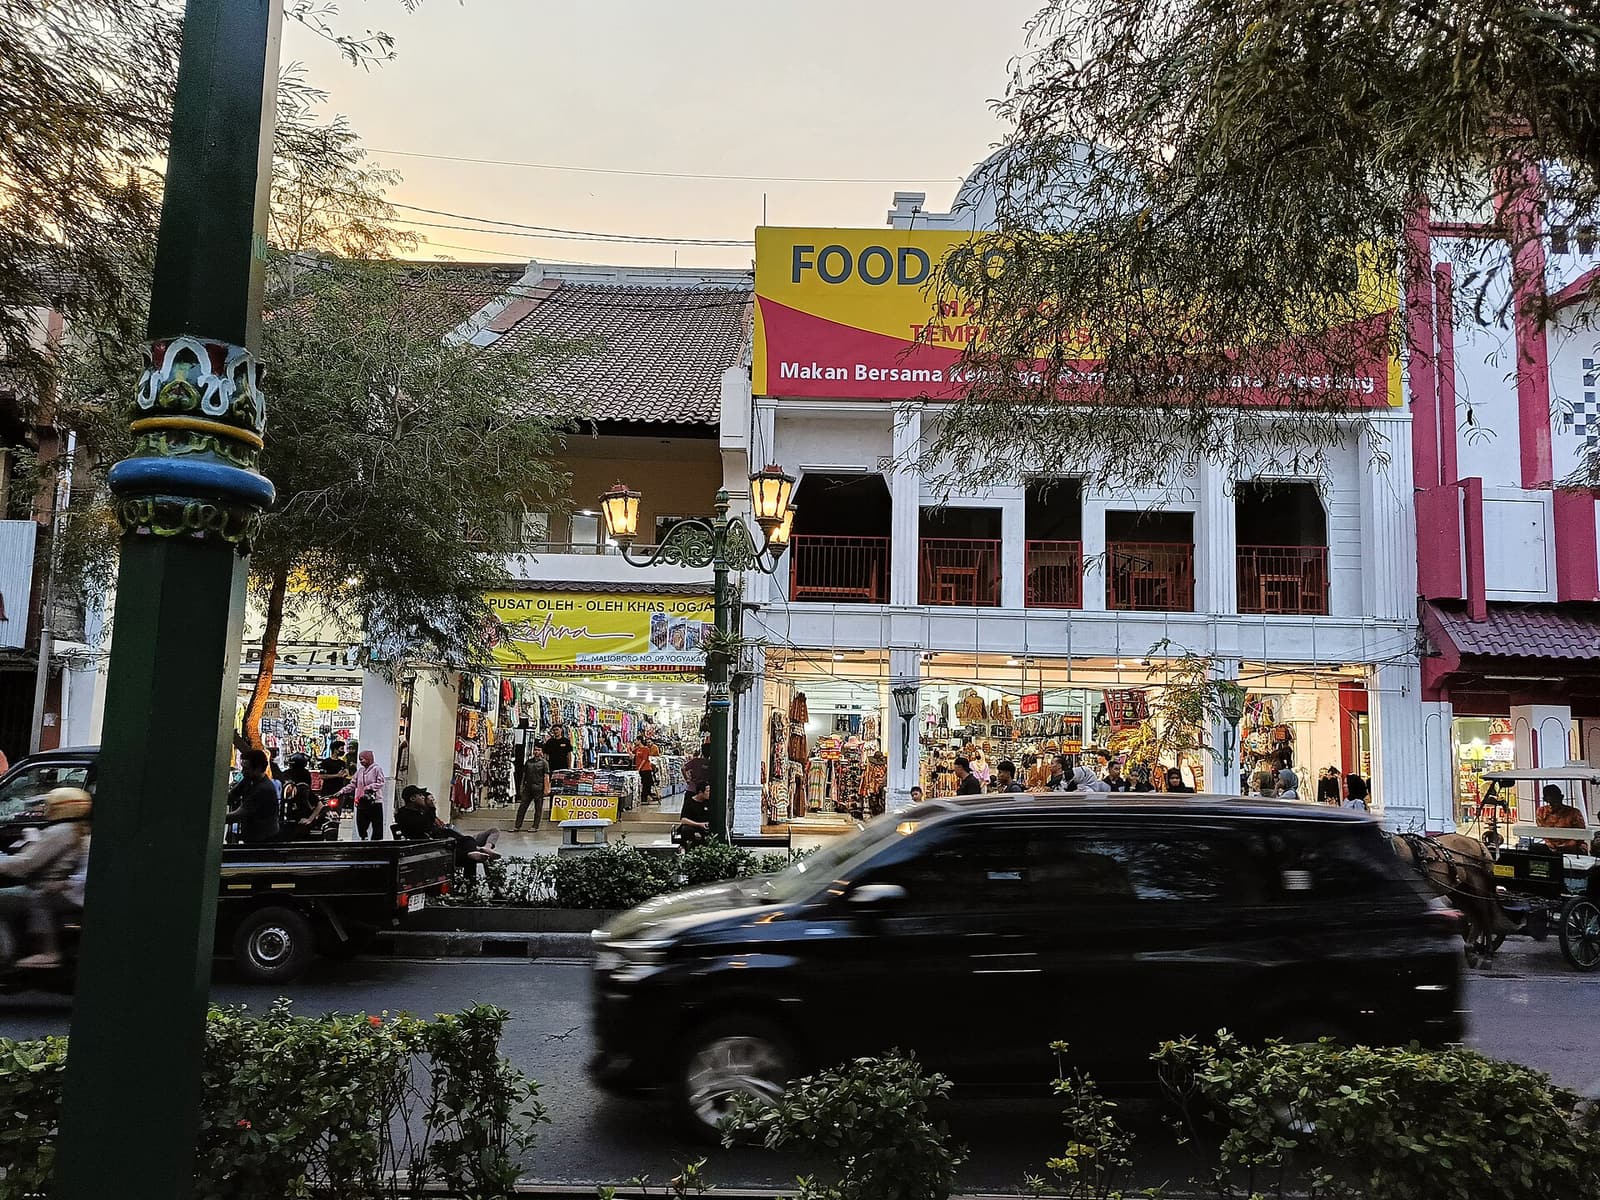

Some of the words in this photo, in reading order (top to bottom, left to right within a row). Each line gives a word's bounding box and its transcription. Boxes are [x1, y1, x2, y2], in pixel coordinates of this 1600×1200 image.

[791, 245, 931, 285] FOOD
[909, 324, 1008, 344] TEMPA
[780, 361, 848, 380] Makan
[855, 364, 943, 382] Bersama
[488, 599, 533, 610] PUSAT
[537, 600, 573, 611] OLEH
[586, 601, 623, 612] OLEH
[627, 601, 665, 613] KHAS
[668, 602, 713, 613] JOGJA
[593, 655, 638, 663] MALIOBORO
[554, 797, 568, 809] Rp
[571, 798, 615, 808] 100.000.-
[568, 811, 575, 819] 7
[577, 811, 599, 819] PCS
